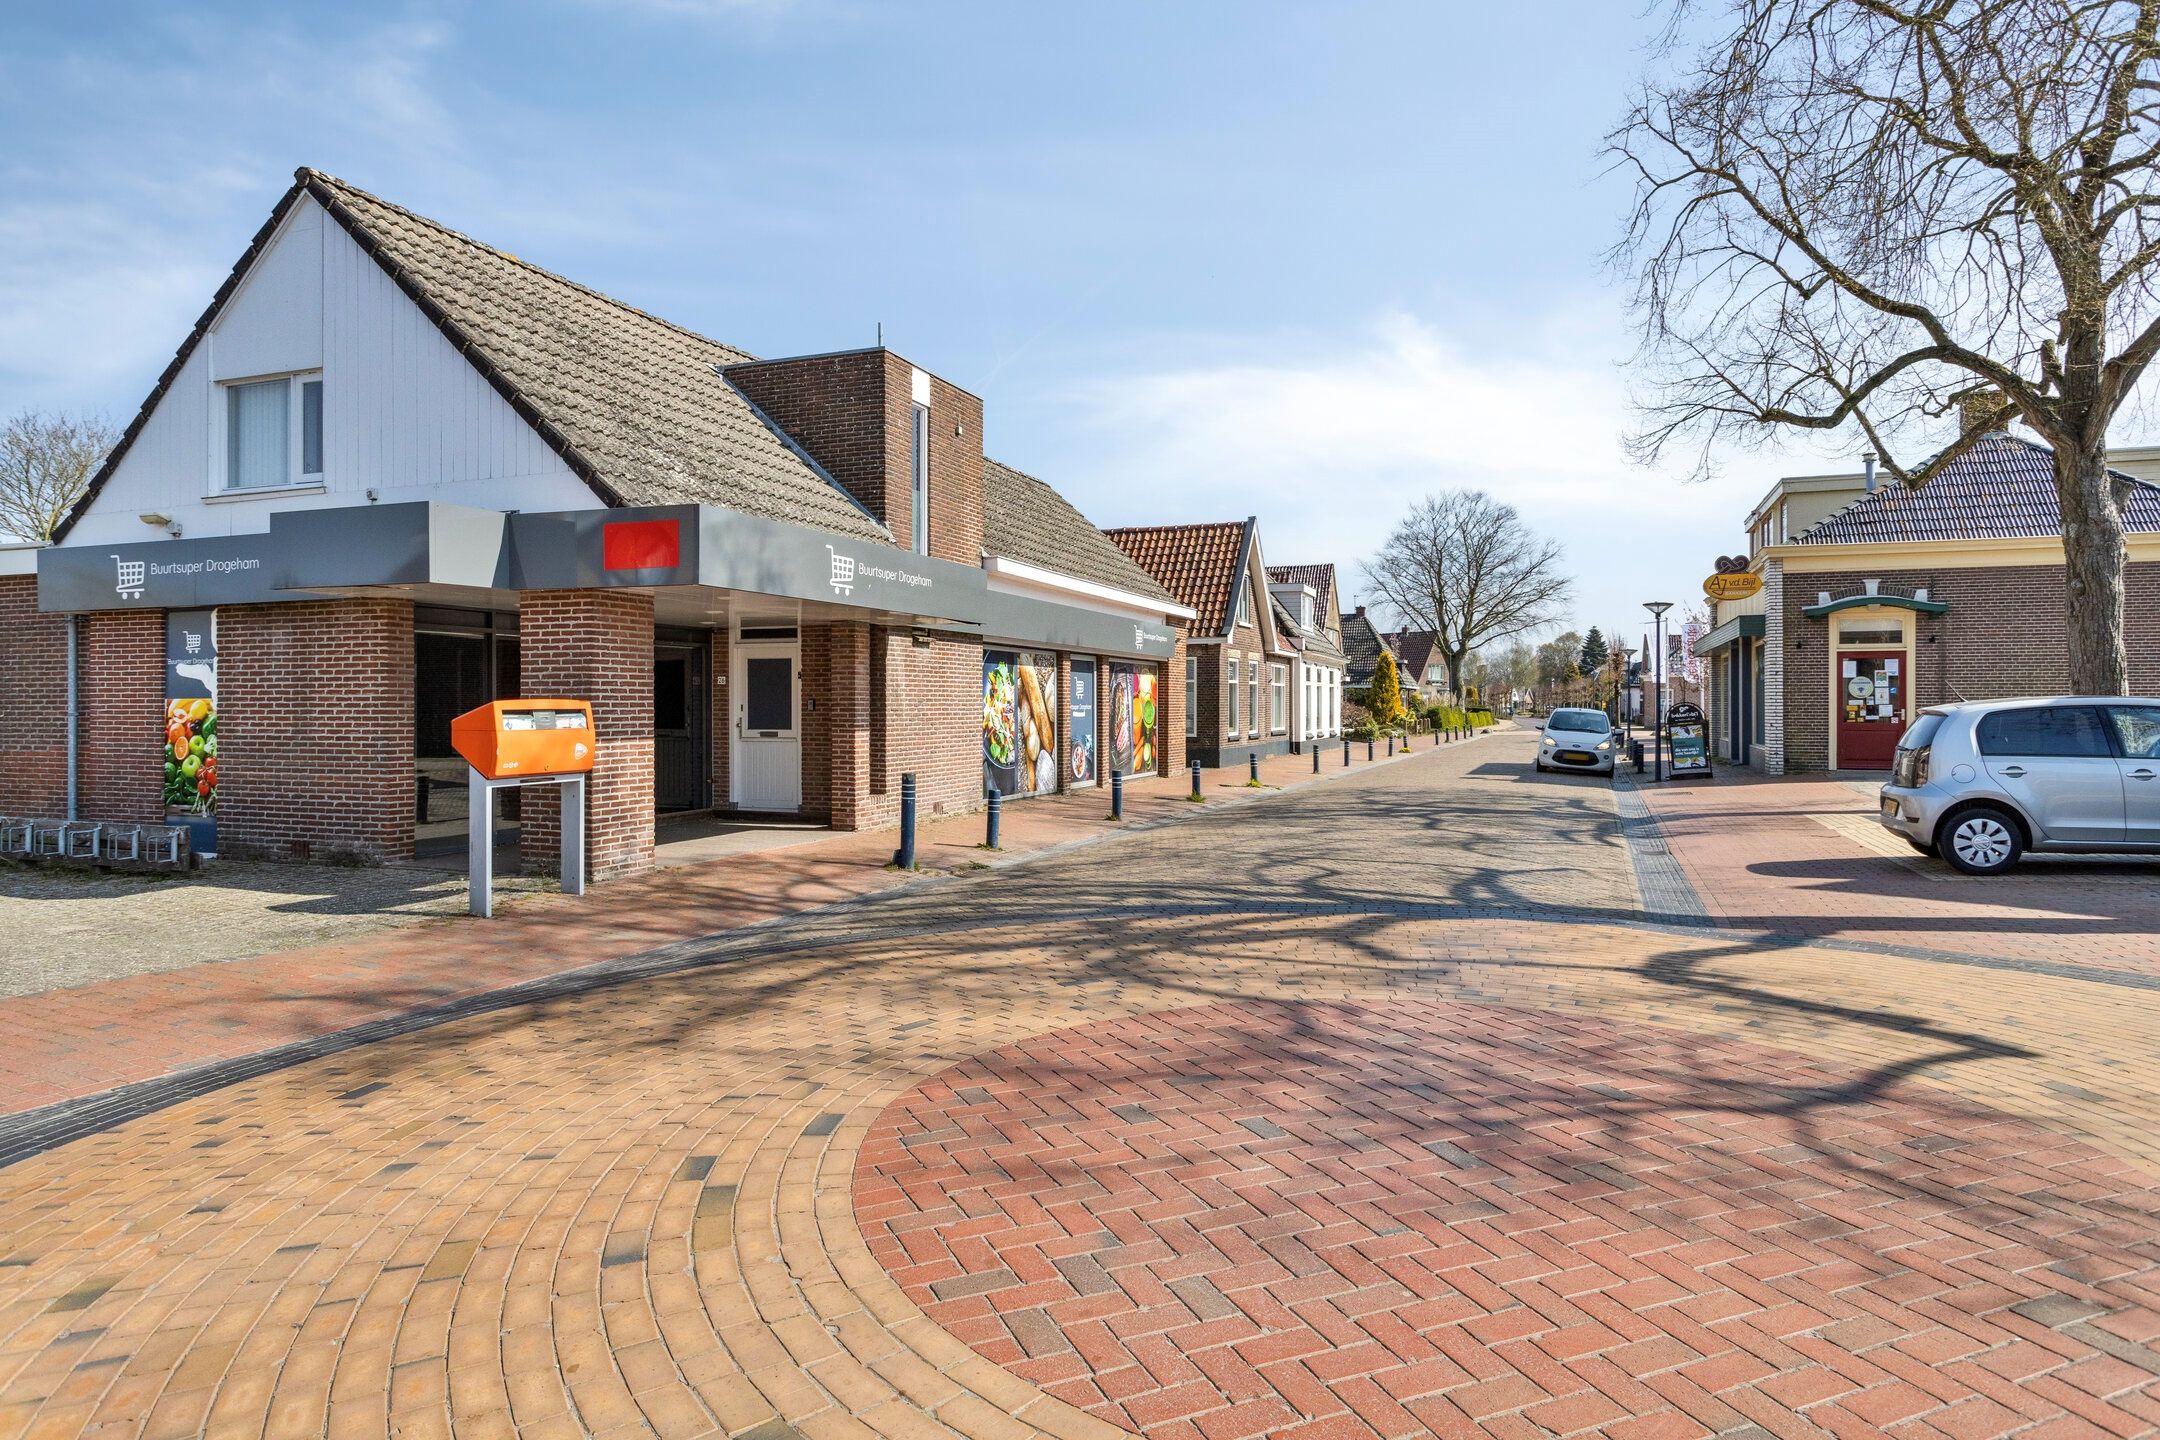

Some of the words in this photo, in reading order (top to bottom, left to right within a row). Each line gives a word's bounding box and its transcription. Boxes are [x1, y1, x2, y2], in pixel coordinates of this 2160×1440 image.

[150, 562, 204, 575] Buurtsuper
[206, 557, 260, 574] Drogeham
[858, 562, 897, 581] Buurtsuper
[898, 570, 932, 587] Drogeham
